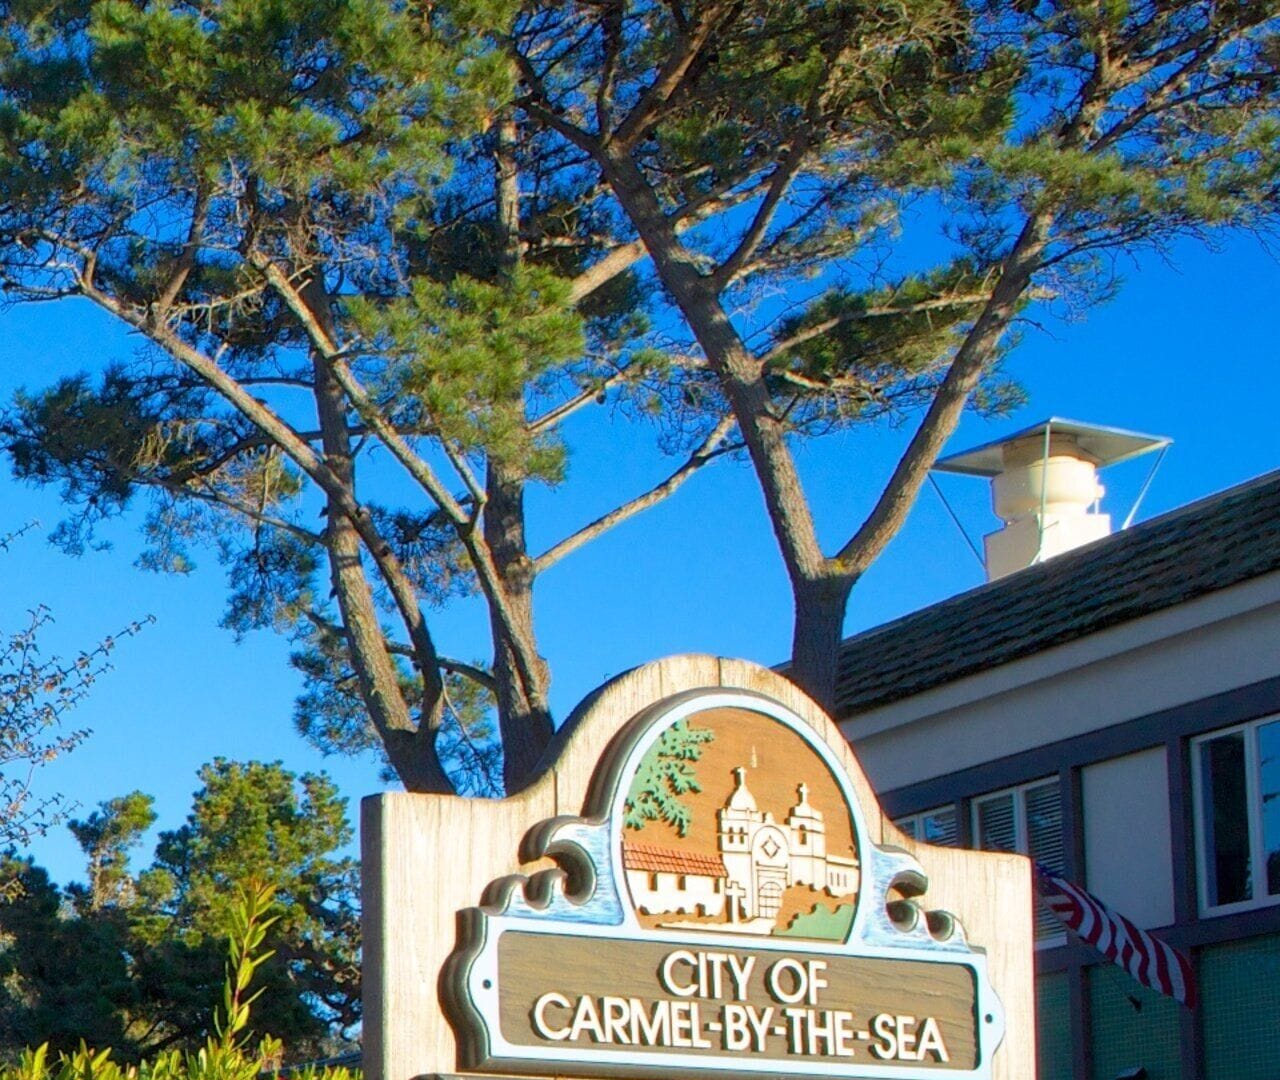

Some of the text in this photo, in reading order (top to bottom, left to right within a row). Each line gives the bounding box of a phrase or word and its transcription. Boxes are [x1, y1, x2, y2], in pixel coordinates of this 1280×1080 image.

[662, 950, 827, 1005] CITY OF
[533, 992, 948, 1062] CARMEL-BY-THE-SEA
